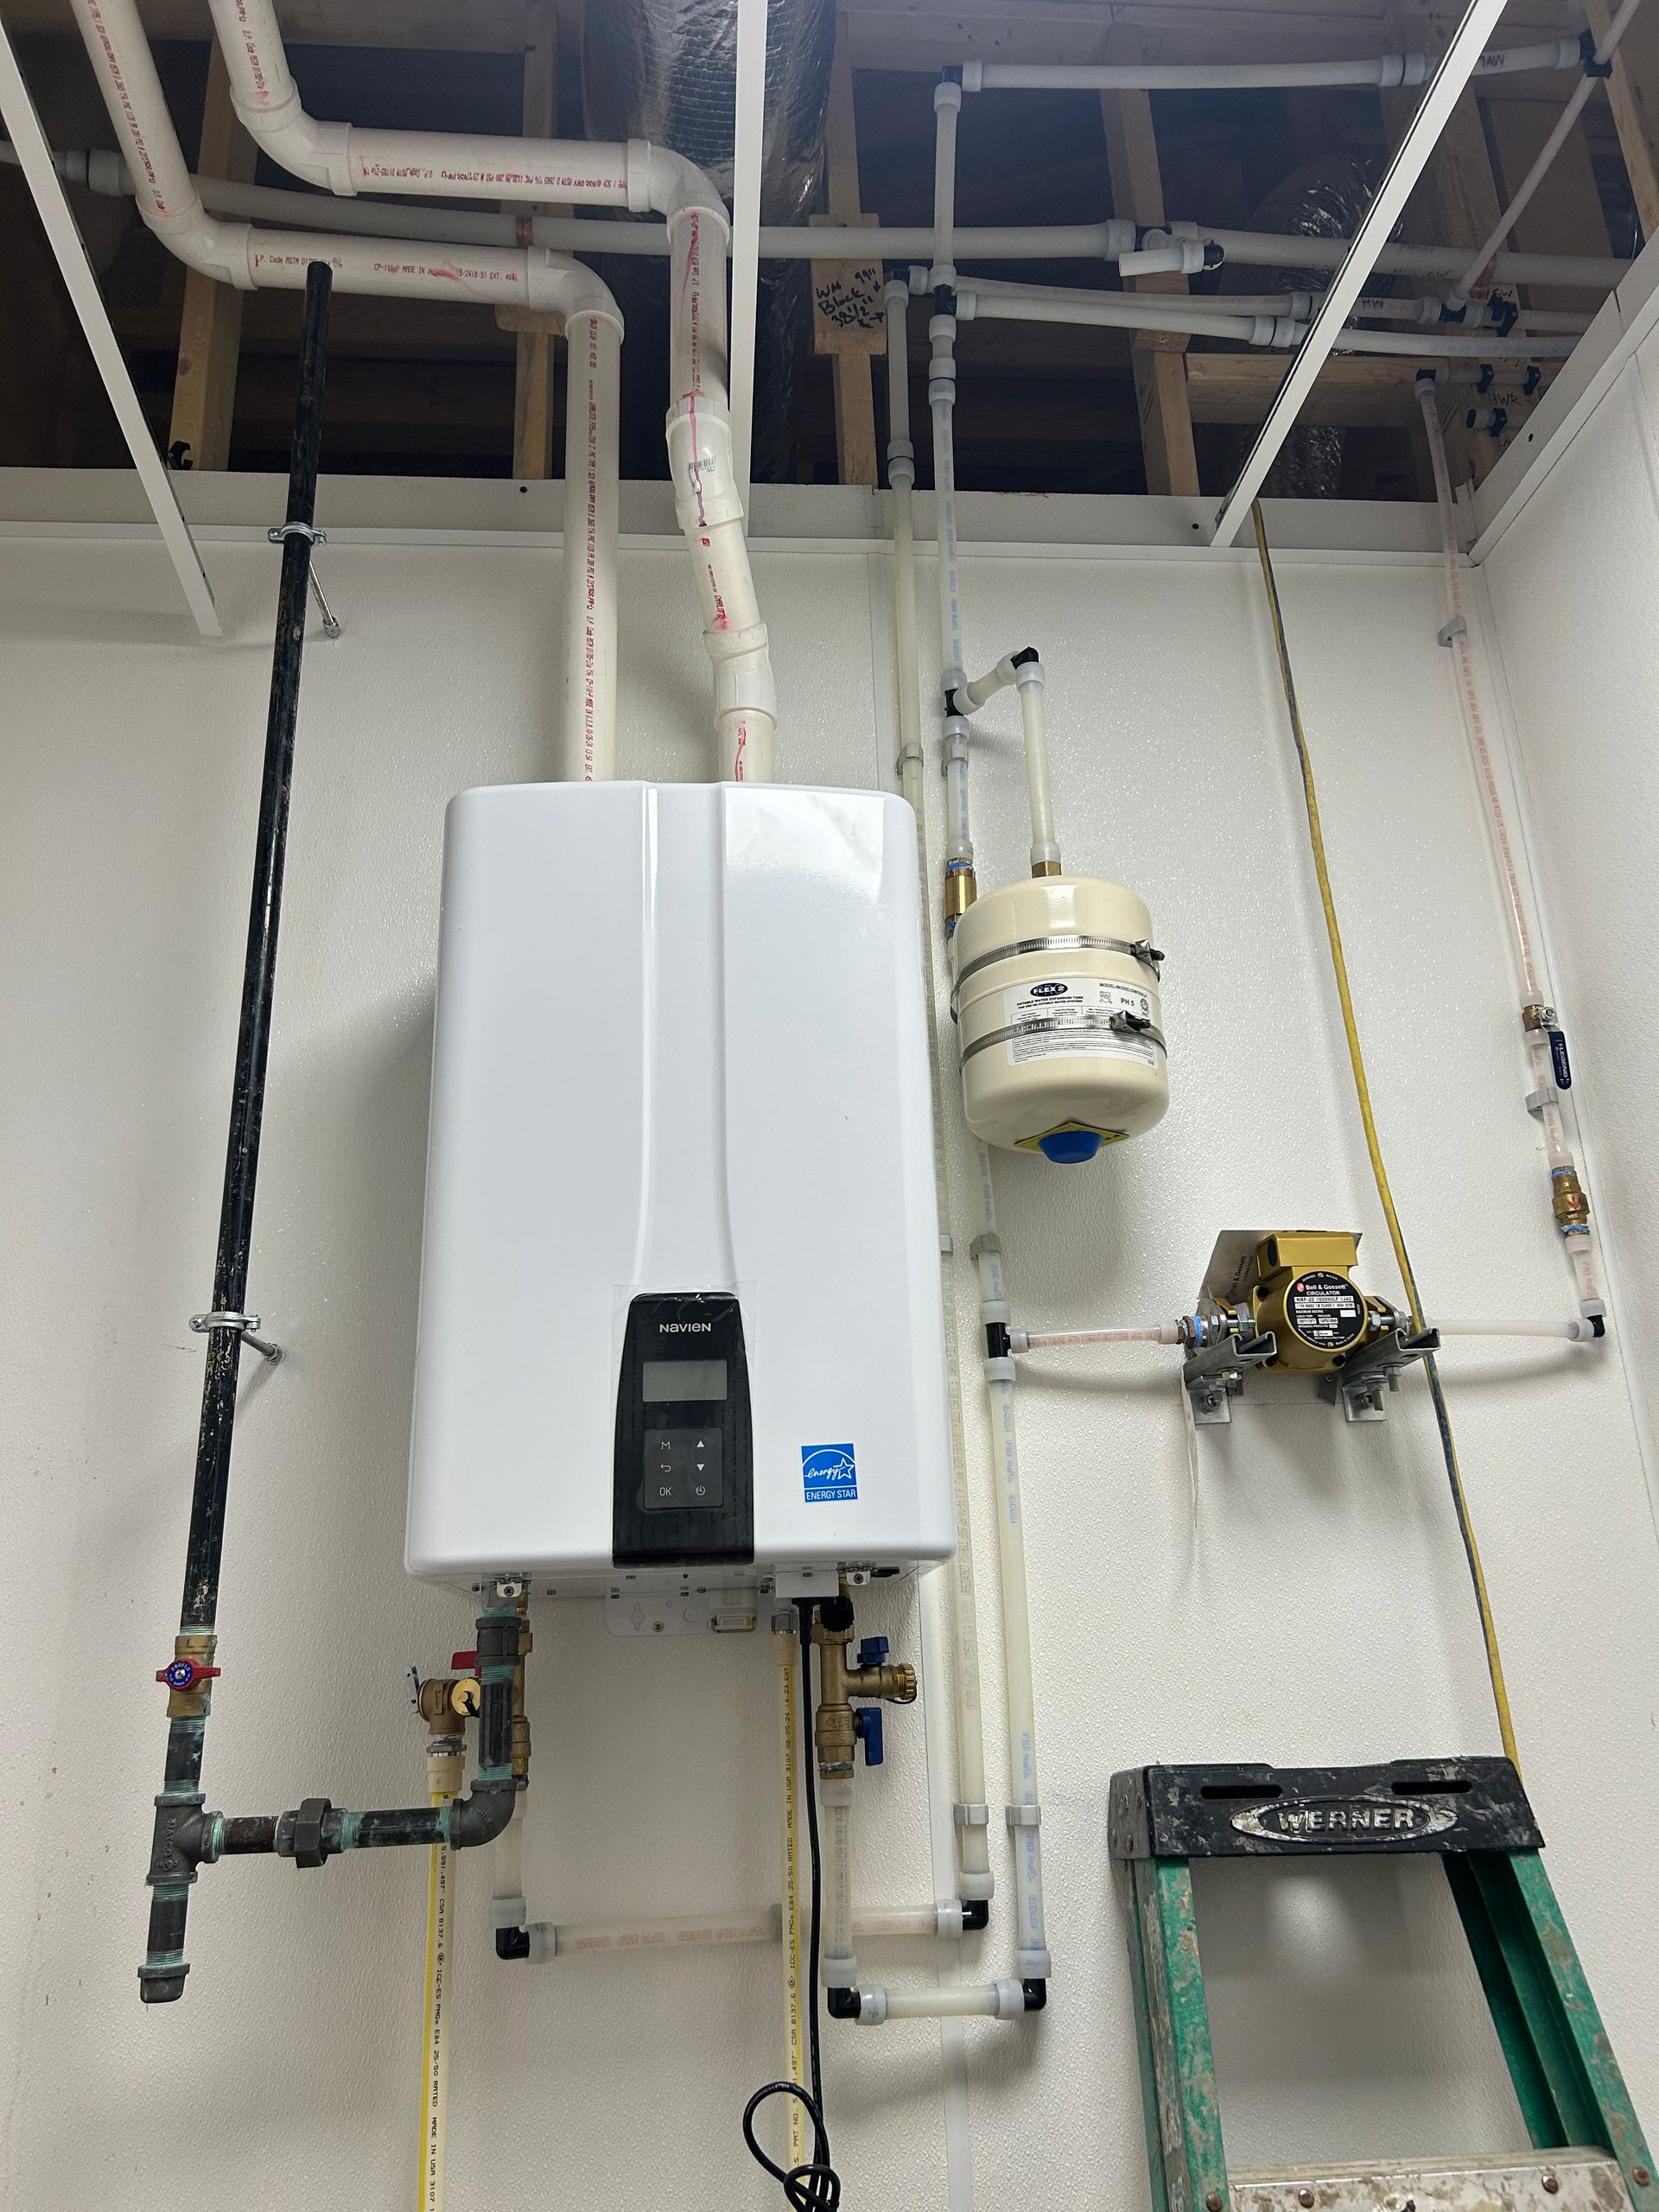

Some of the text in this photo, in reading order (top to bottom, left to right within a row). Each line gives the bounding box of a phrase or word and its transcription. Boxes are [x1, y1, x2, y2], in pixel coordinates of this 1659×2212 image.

[1558, 1046, 1568, 1077] LEGEND
[661, 1440, 671, 1449] M
[659, 1487, 672, 1496] OK
[806, 1489, 855, 1500] ENERGY STAR
[786, 1795, 791, 1803] IN
[1276, 1806, 1415, 1834] WERNER
[430, 2144, 436, 2154] IN
